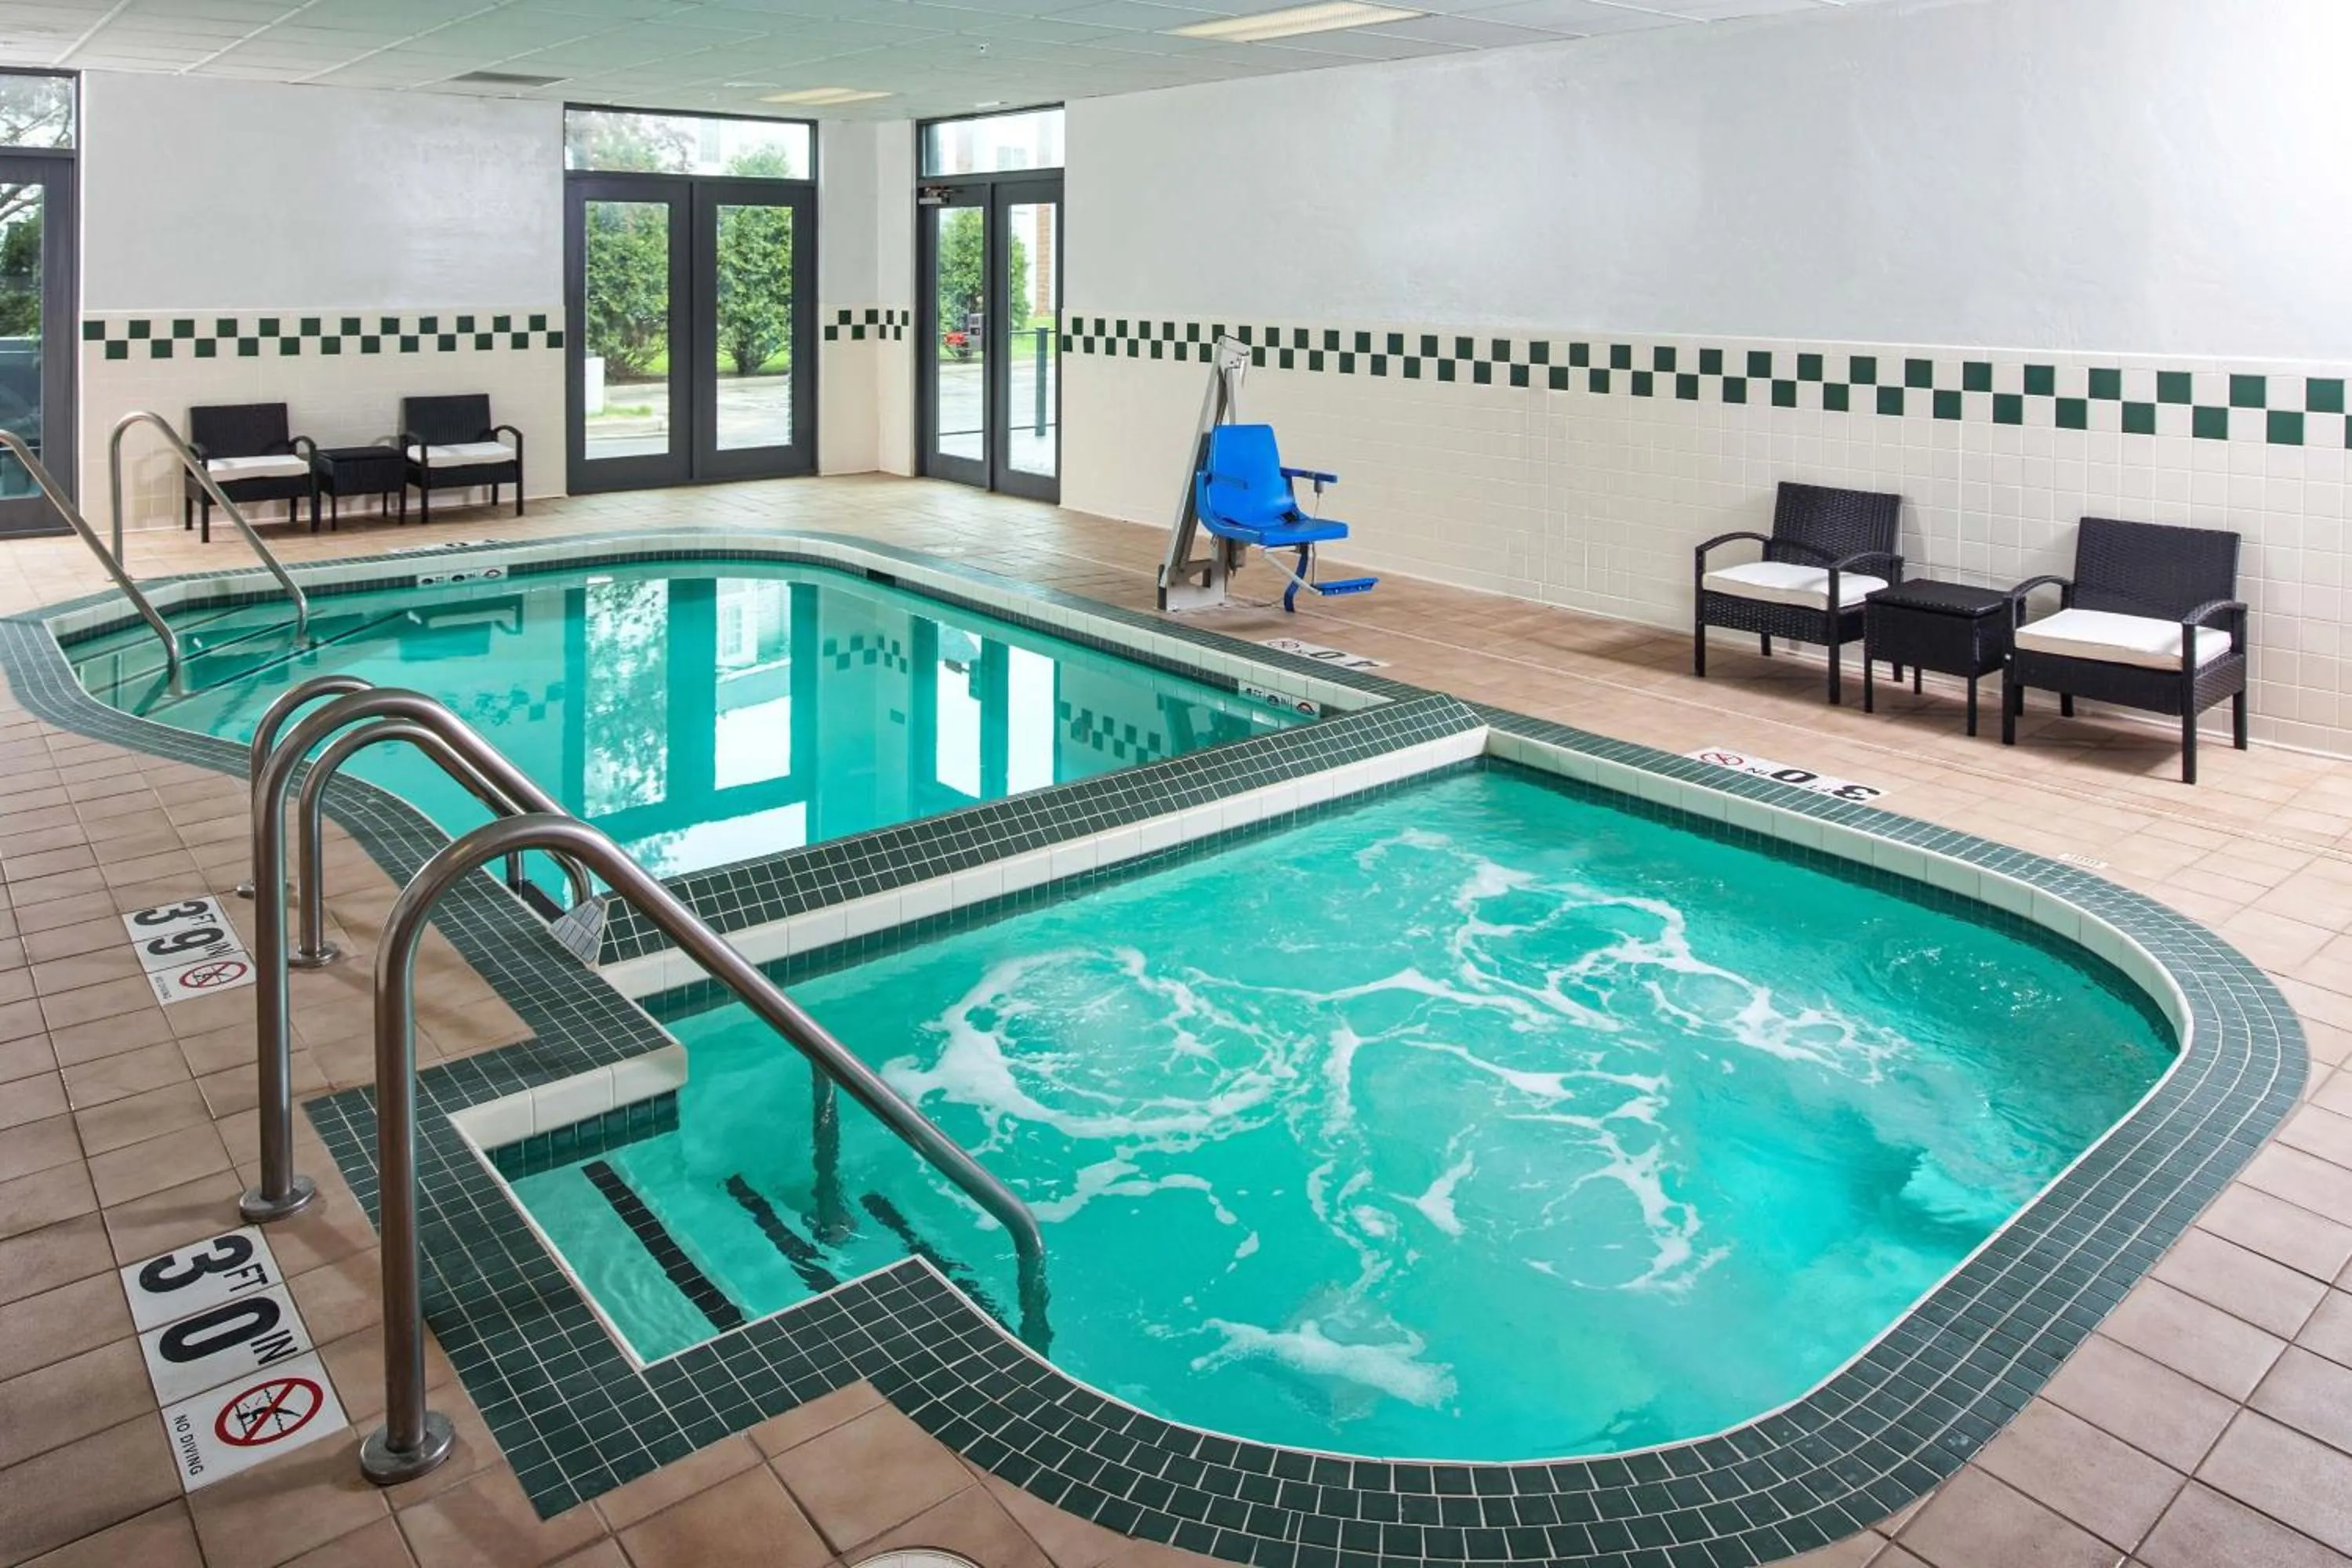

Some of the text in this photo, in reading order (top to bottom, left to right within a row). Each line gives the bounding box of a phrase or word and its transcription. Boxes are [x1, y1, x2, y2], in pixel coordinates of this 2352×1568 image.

[1769, 769, 1819, 783] 0
[1831, 785, 1880, 801] 3
[134, 902, 209, 925] 3
[189, 914, 216, 925] FT
[147, 928, 224, 955] 9
[139, 1235, 298, 1365] 3 FT 0 IN
[173, 1414, 204, 1475] NO DIVING
